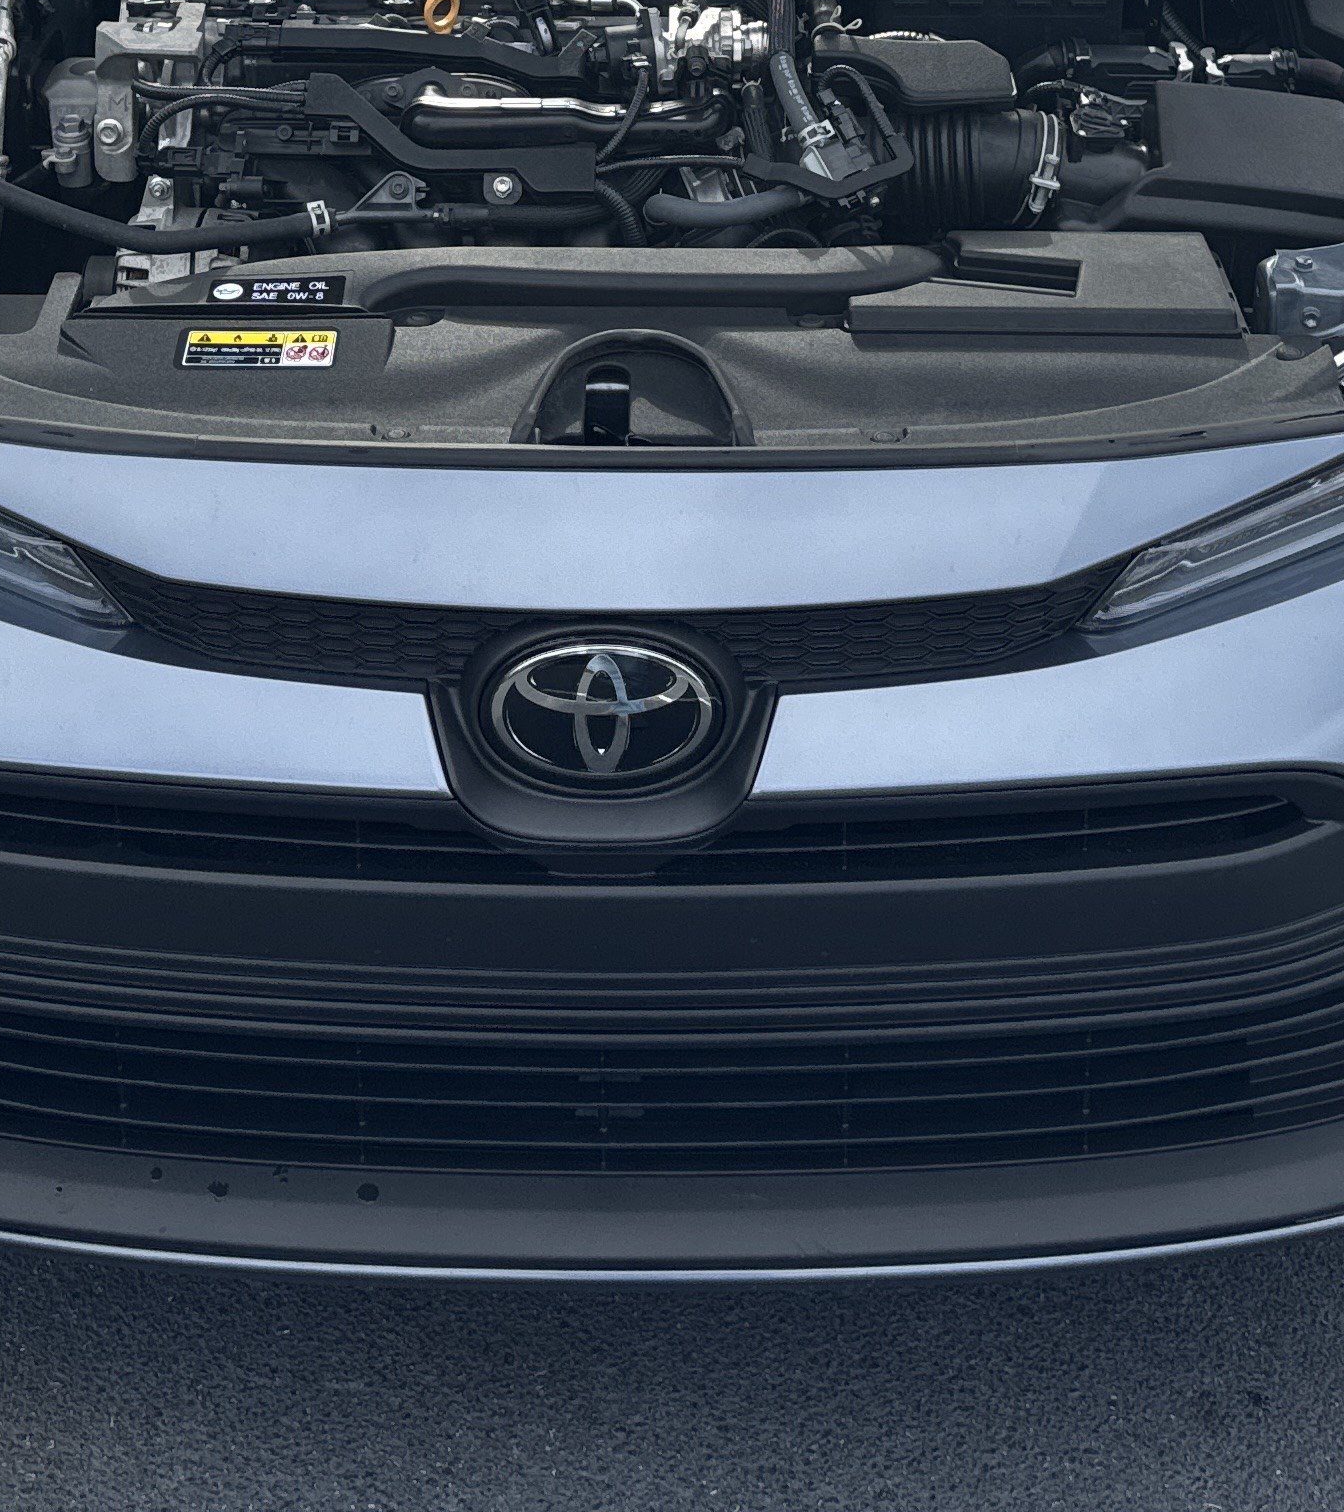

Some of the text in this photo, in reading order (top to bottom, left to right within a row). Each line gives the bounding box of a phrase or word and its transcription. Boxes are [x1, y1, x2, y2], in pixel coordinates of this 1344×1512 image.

[253, 281, 330, 291] ENGINE OIL
[251, 291, 278, 300] SAE
